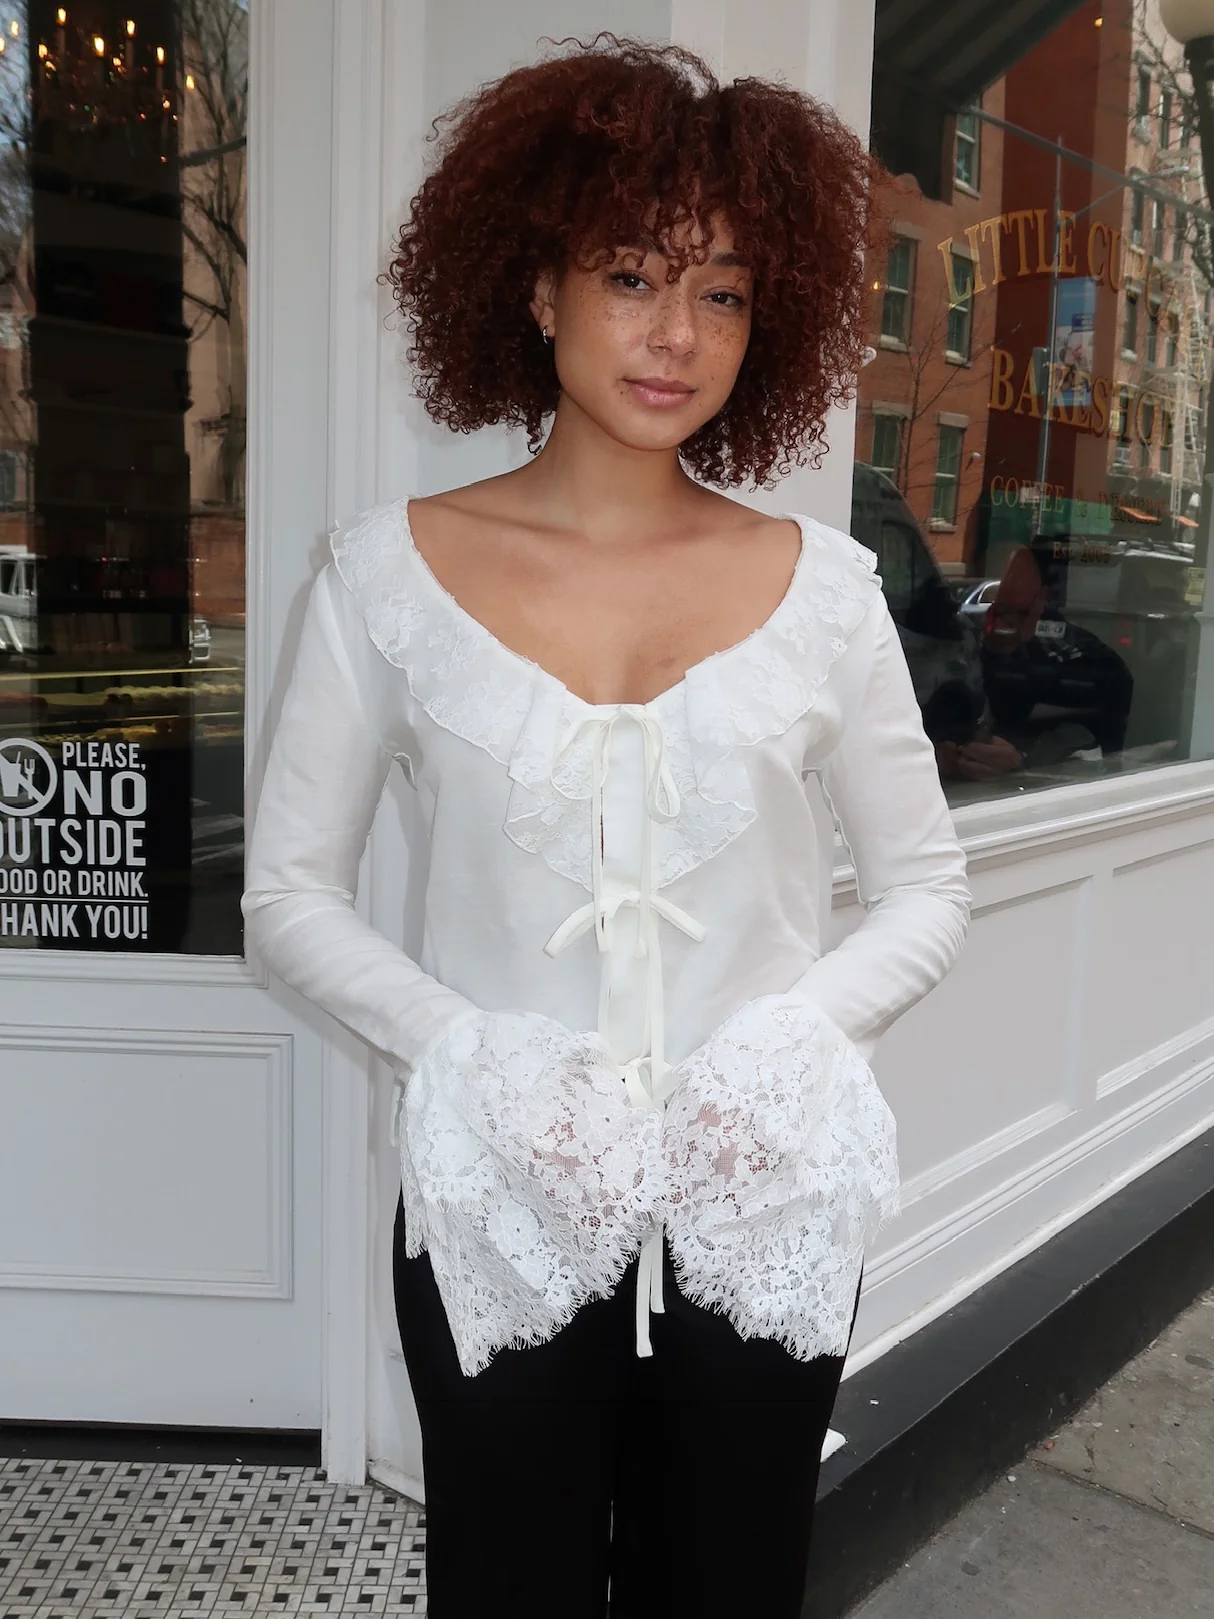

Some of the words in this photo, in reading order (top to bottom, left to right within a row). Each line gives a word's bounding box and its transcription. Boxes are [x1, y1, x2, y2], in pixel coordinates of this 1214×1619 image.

[938, 209, 1077, 309] LITTLE
[990, 475, 1065, 514] COFFEE
[62, 741, 147, 771] PLEASE,
[63, 769, 147, 817] NO
[0, 818, 147, 866] UTSIDE
[0, 868, 38, 895] OOD
[43, 870, 72, 896] OR
[77, 870, 149, 898] DRINK.
[0, 902, 80, 938] HANK
[84, 904, 149, 940] YOU!
